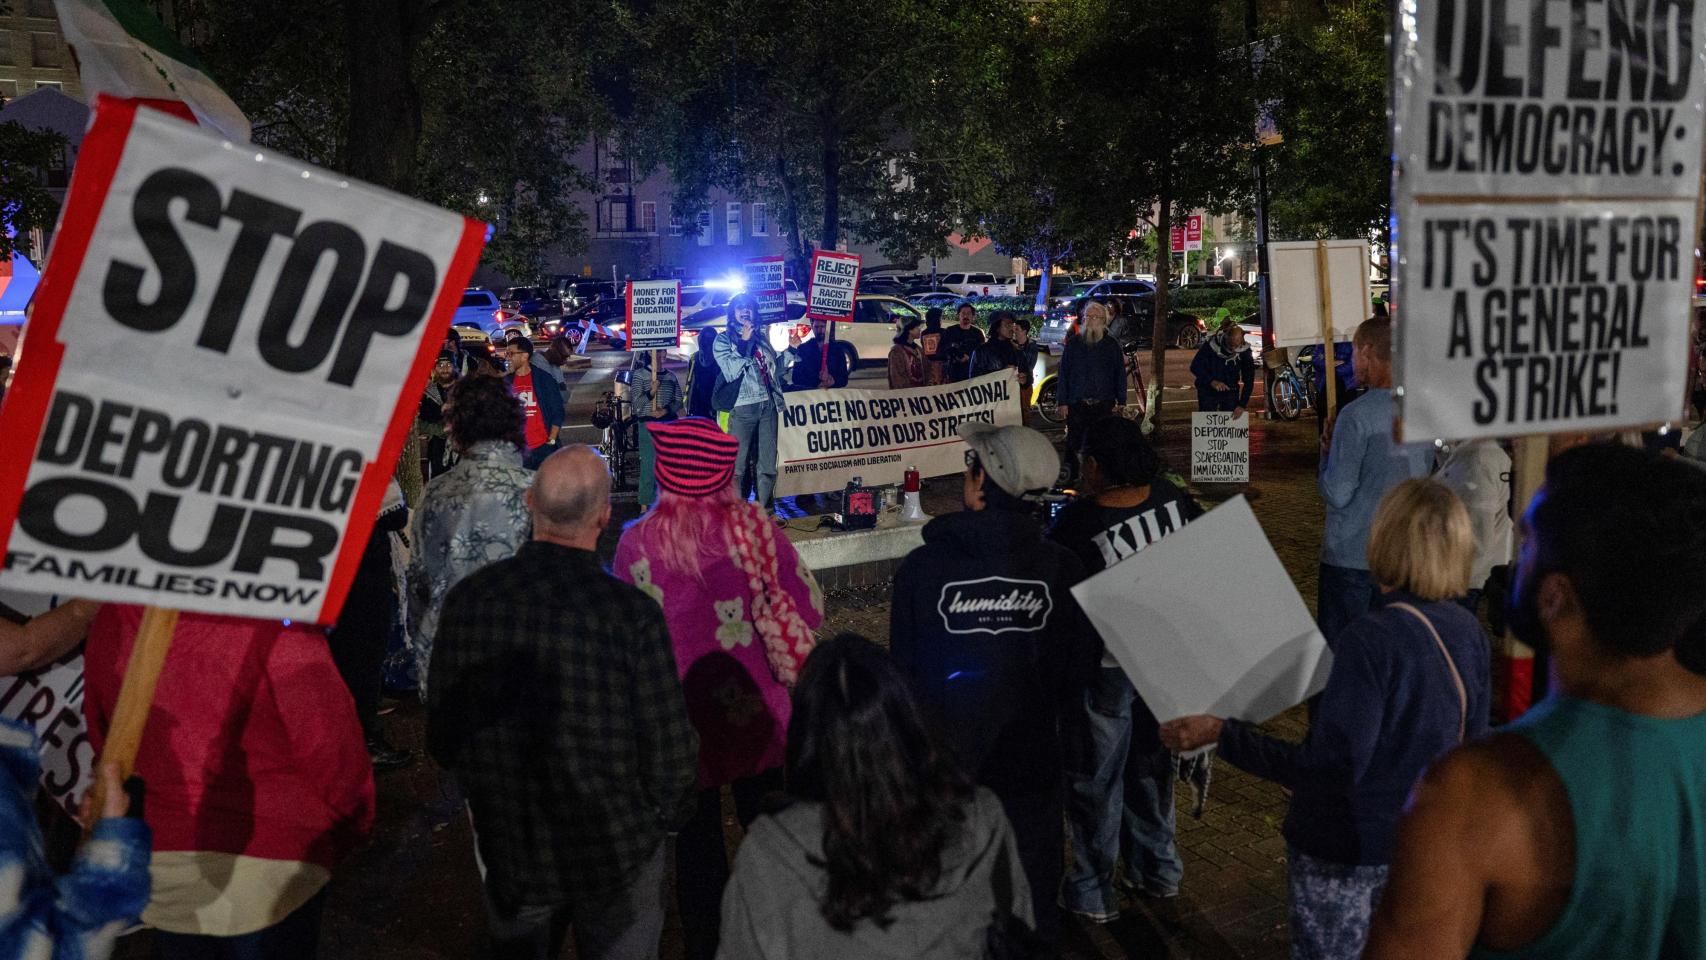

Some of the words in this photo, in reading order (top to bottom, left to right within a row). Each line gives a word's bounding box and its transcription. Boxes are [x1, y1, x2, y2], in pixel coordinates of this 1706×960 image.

[1435, 0, 1692, 101] DEFEND
[1427, 102, 1686, 176] DEMOCRACY:
[1422, 218, 1498, 289] IT'S
[1506, 217, 1598, 287] TIME
[1607, 216, 1680, 283] FOR
[817, 260, 858, 276] REJECT
[103, 167, 437, 387] STOP
[817, 274, 852, 287] TRUMP'S
[633, 288, 660, 296] MONEY
[662, 287, 676, 295] FOR
[819, 288, 848, 299] RACIST
[634, 297, 656, 305] JOBS
[658, 296, 675, 305] AND
[812, 296, 852, 309] TAKEOVER
[633, 306, 676, 314] EDUCATION,
[646, 319, 677, 327] MILITARY
[1448, 291, 1474, 359] A
[1482, 284, 1650, 356] GENERAL
[632, 327, 676, 335] OCCUPATION!
[1471, 352, 1621, 426] STRIKE!
[783, 403, 807, 428] NO
[810, 401, 842, 425] ICE!
[846, 399, 867, 422] NO
[869, 398, 907, 421] CBP!
[908, 396, 933, 416] NO
[933, 380, 1010, 412] NATIONAL
[1206, 414, 1230, 426] STOP
[807, 425, 864, 453] GUARD
[867, 424, 891, 448] ON
[893, 421, 927, 445] OUR
[1194, 426, 1248, 439] DEPORTATIONS
[37, 390, 364, 514] DEPORTING
[1207, 439, 1229, 451] STOP
[785, 464, 805, 474] PARTY
[806, 463, 818, 472] FOR
[819, 460, 852, 471] SOCIALISM
[853, 458, 866, 467] AND
[867, 454, 902, 465] LIBERATION
[1194, 451, 1248, 464] SCAPEGOATING
[1193, 464, 1244, 476] IMMIGRANTS
[18, 476, 339, 582] OUR
[3, 552, 215, 596] FAMILIES
[220, 580, 320, 605] NOW
[949, 589, 1043, 619] humidity
